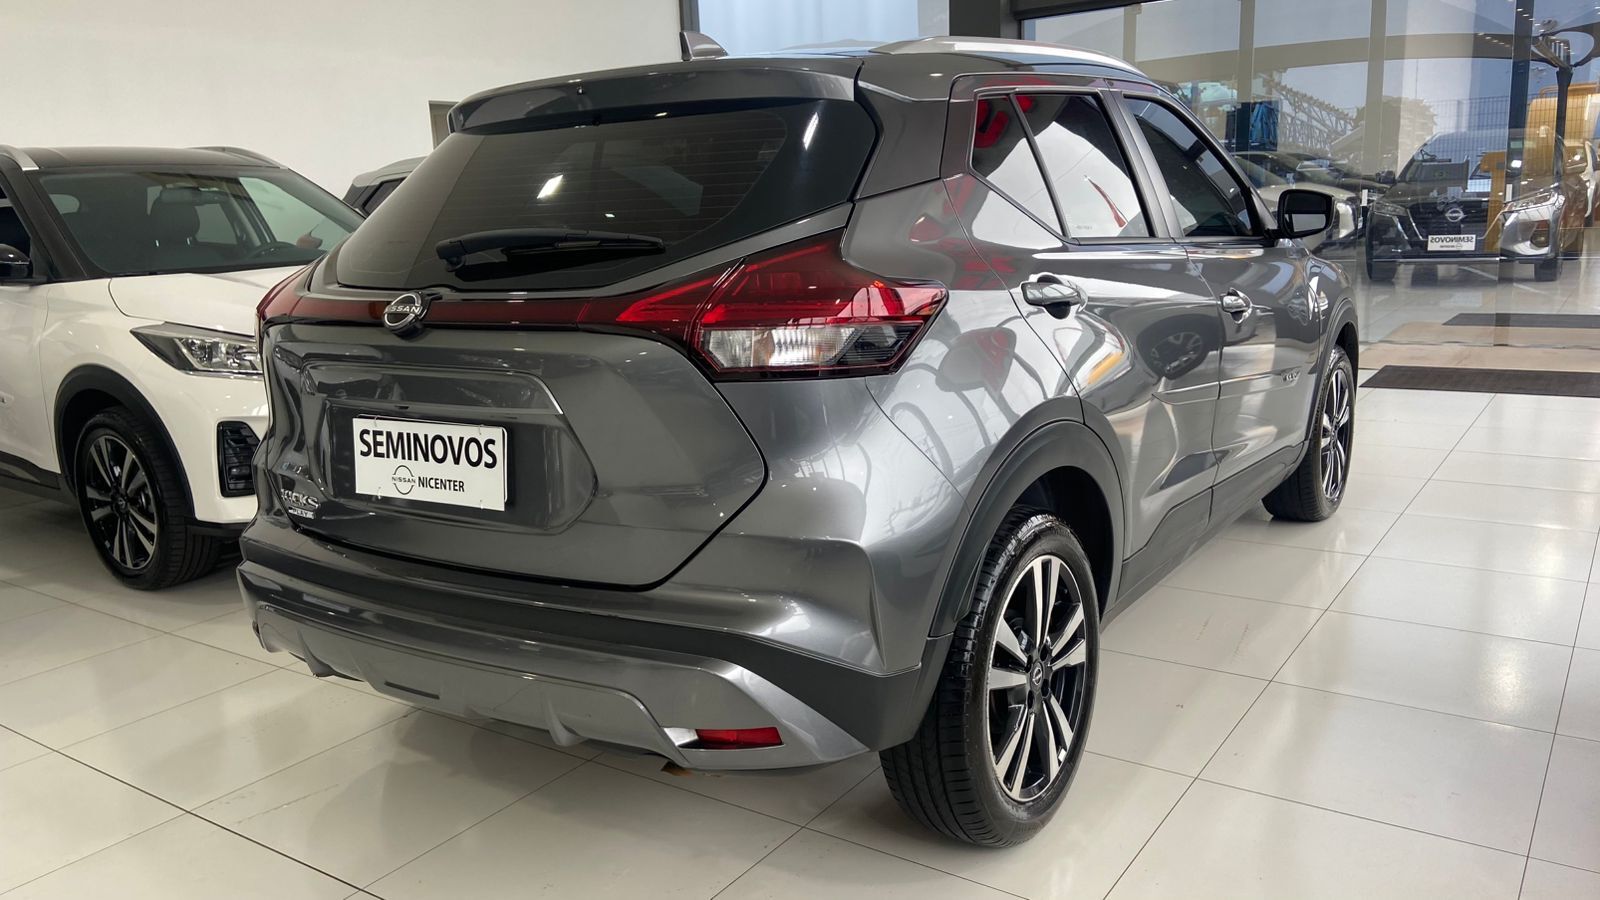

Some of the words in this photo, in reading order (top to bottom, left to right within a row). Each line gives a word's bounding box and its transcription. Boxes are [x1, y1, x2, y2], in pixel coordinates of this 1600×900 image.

[385, 304, 421, 315] SSAN
[359, 428, 498, 469] SEMINOVOS
[391, 476, 416, 484] NISSAN
[418, 476, 465, 493] NICENTER
